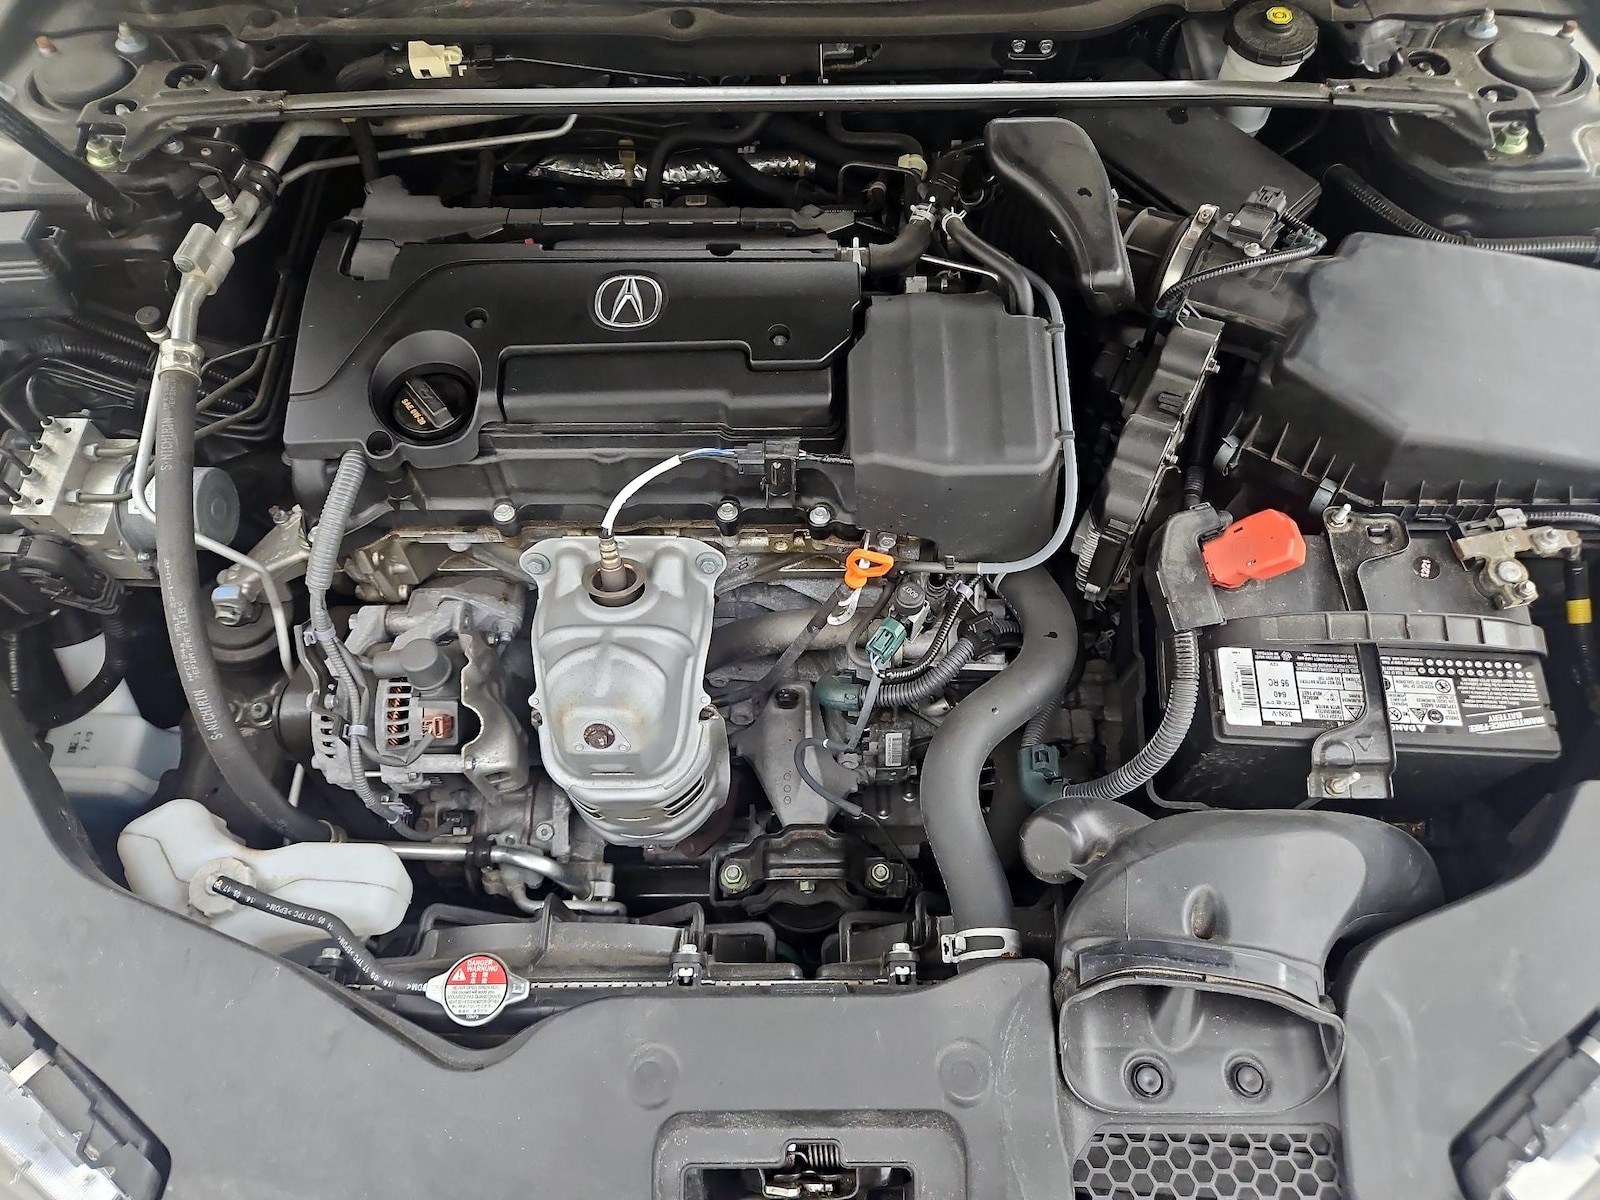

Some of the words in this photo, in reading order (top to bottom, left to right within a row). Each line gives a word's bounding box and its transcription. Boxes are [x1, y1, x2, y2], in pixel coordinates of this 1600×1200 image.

[401, 398, 415, 411] SAE
[1268, 678, 1279, 687] RC
[1281, 679, 1290, 688] 95
[1273, 690, 1287, 699] 640
[1487, 711, 1523, 722] BATTERY
[1467, 716, 1546, 733] MAINTENANCE-FREE
[293, 908, 307, 920] TPC
[352, 953, 364, 968] TPC
